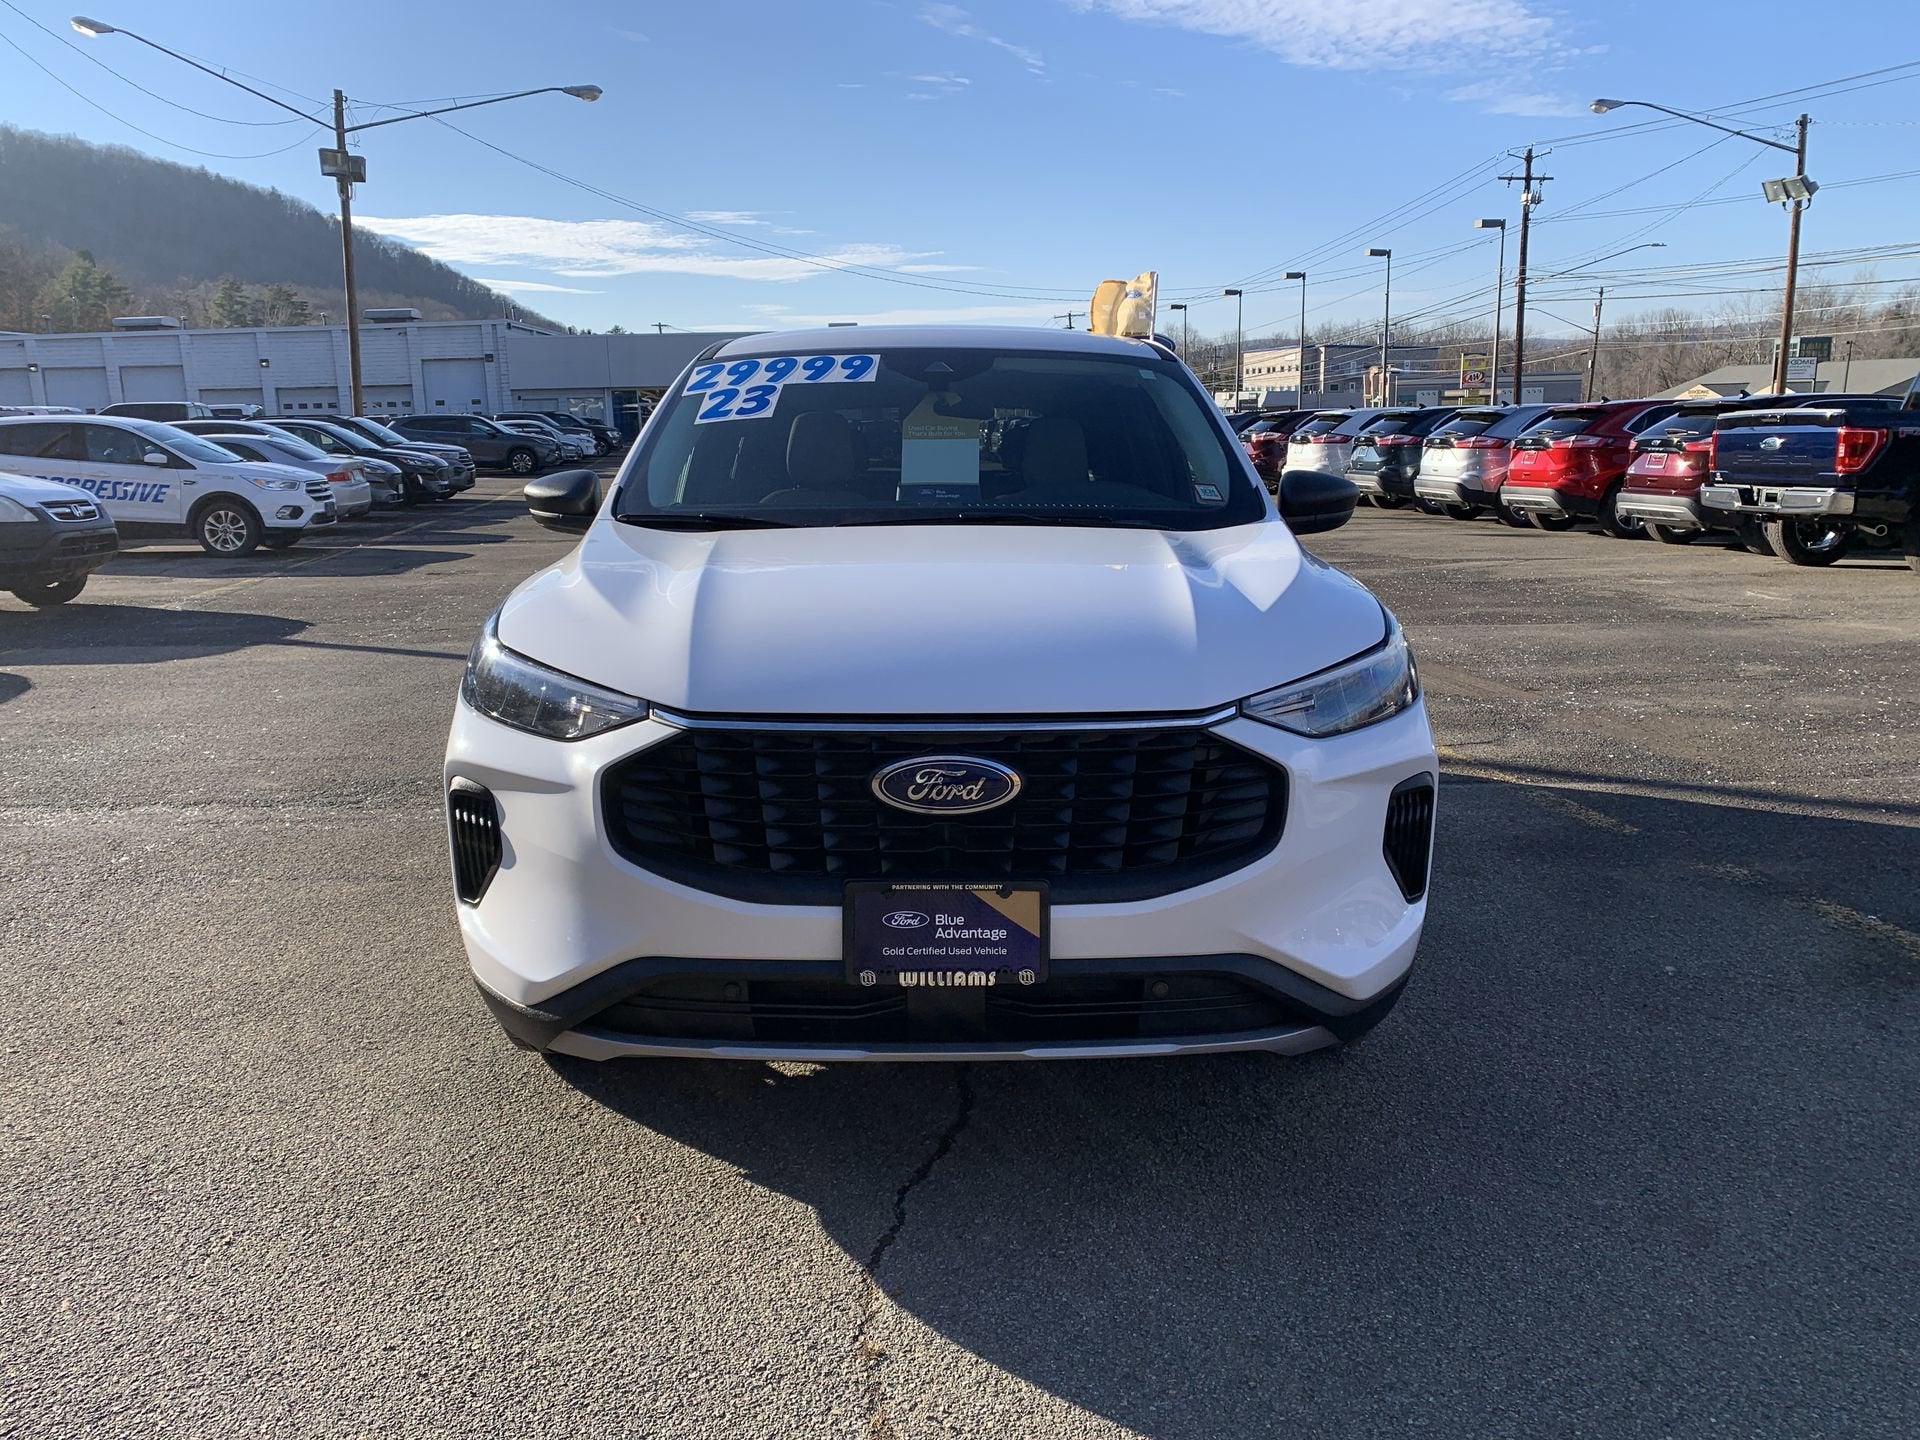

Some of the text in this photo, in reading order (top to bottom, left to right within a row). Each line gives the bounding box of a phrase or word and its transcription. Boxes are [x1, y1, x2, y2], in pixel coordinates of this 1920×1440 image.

[687, 355, 872, 391] 29999
[698, 385, 777, 420] 23
[28, 474, 170, 503] RESSIVE
[907, 768, 985, 801] Ford
[891, 913, 965, 926] Ford Blue
[935, 927, 1007, 941] Advantage
[882, 946, 1008, 956] Gold Certified Used Vehicle
[898, 971, 997, 987] WILLIAMS
